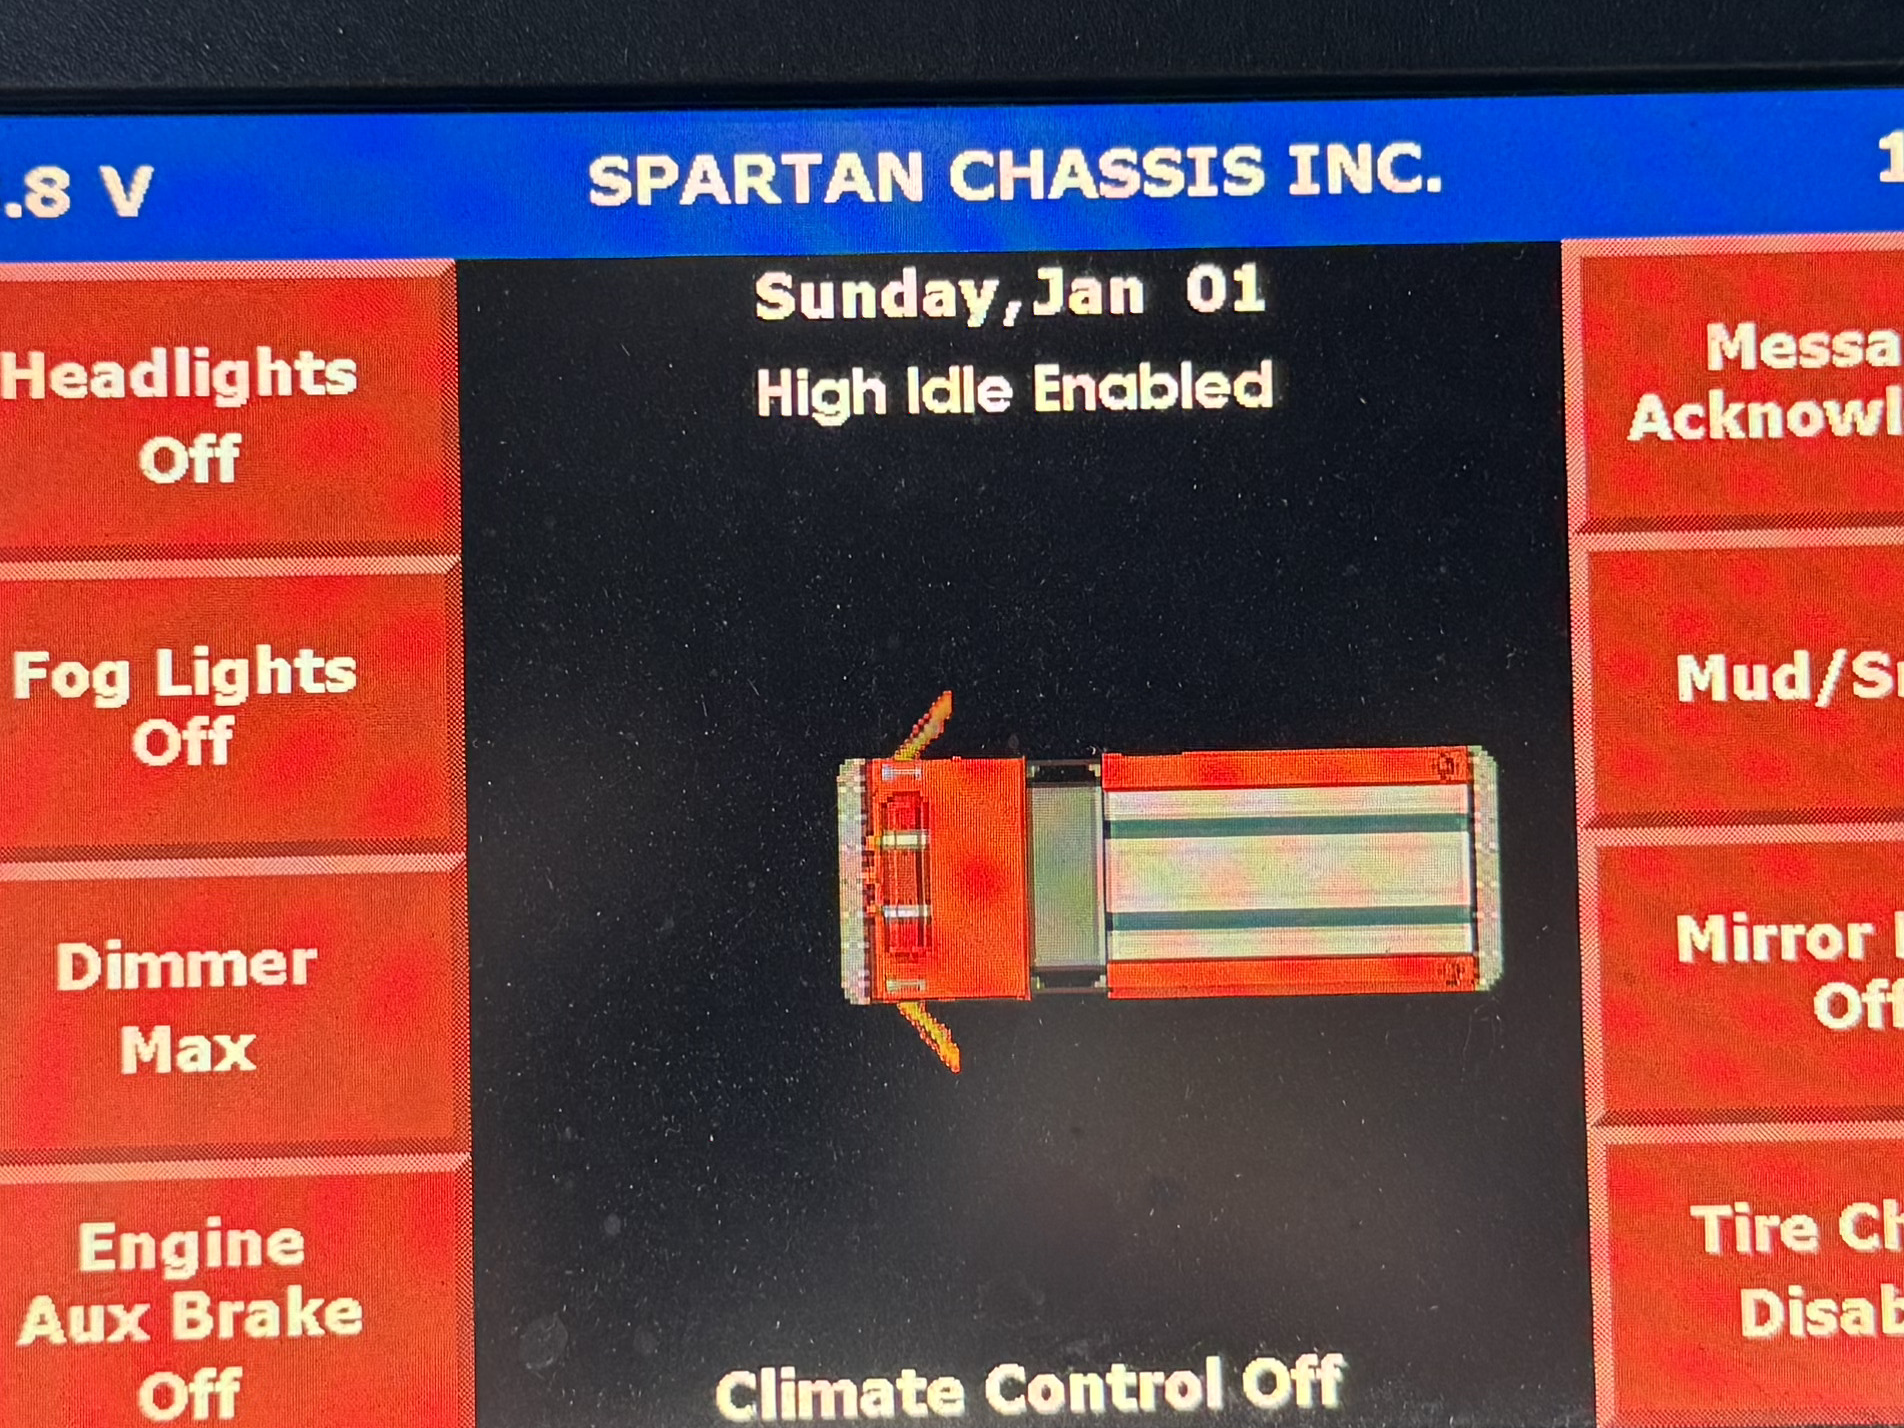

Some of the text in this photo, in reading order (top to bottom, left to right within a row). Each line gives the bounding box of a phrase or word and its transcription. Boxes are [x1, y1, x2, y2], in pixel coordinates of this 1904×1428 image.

[98, 164, 156, 218] V
[588, 140, 1443, 208] SPARTAN CHASSIS INC.
[1185, 261, 1267, 314] 01
[756, 358, 1274, 428] High Idle Enabled
[138, 431, 244, 485] Off
[12, 642, 358, 710] Fog Lights
[131, 713, 237, 768] Off
[56, 937, 319, 992] Dimmer
[1676, 910, 1876, 964] Mirror
[120, 1024, 258, 1076] Max
[78, 1215, 306, 1282] Engine
[1688, 1200, 1821, 1256] Tire
[14, 1283, 364, 1348] Aux Brake
[137, 1365, 244, 1423] Off
[714, 1351, 1349, 1424] Climate Control Off
